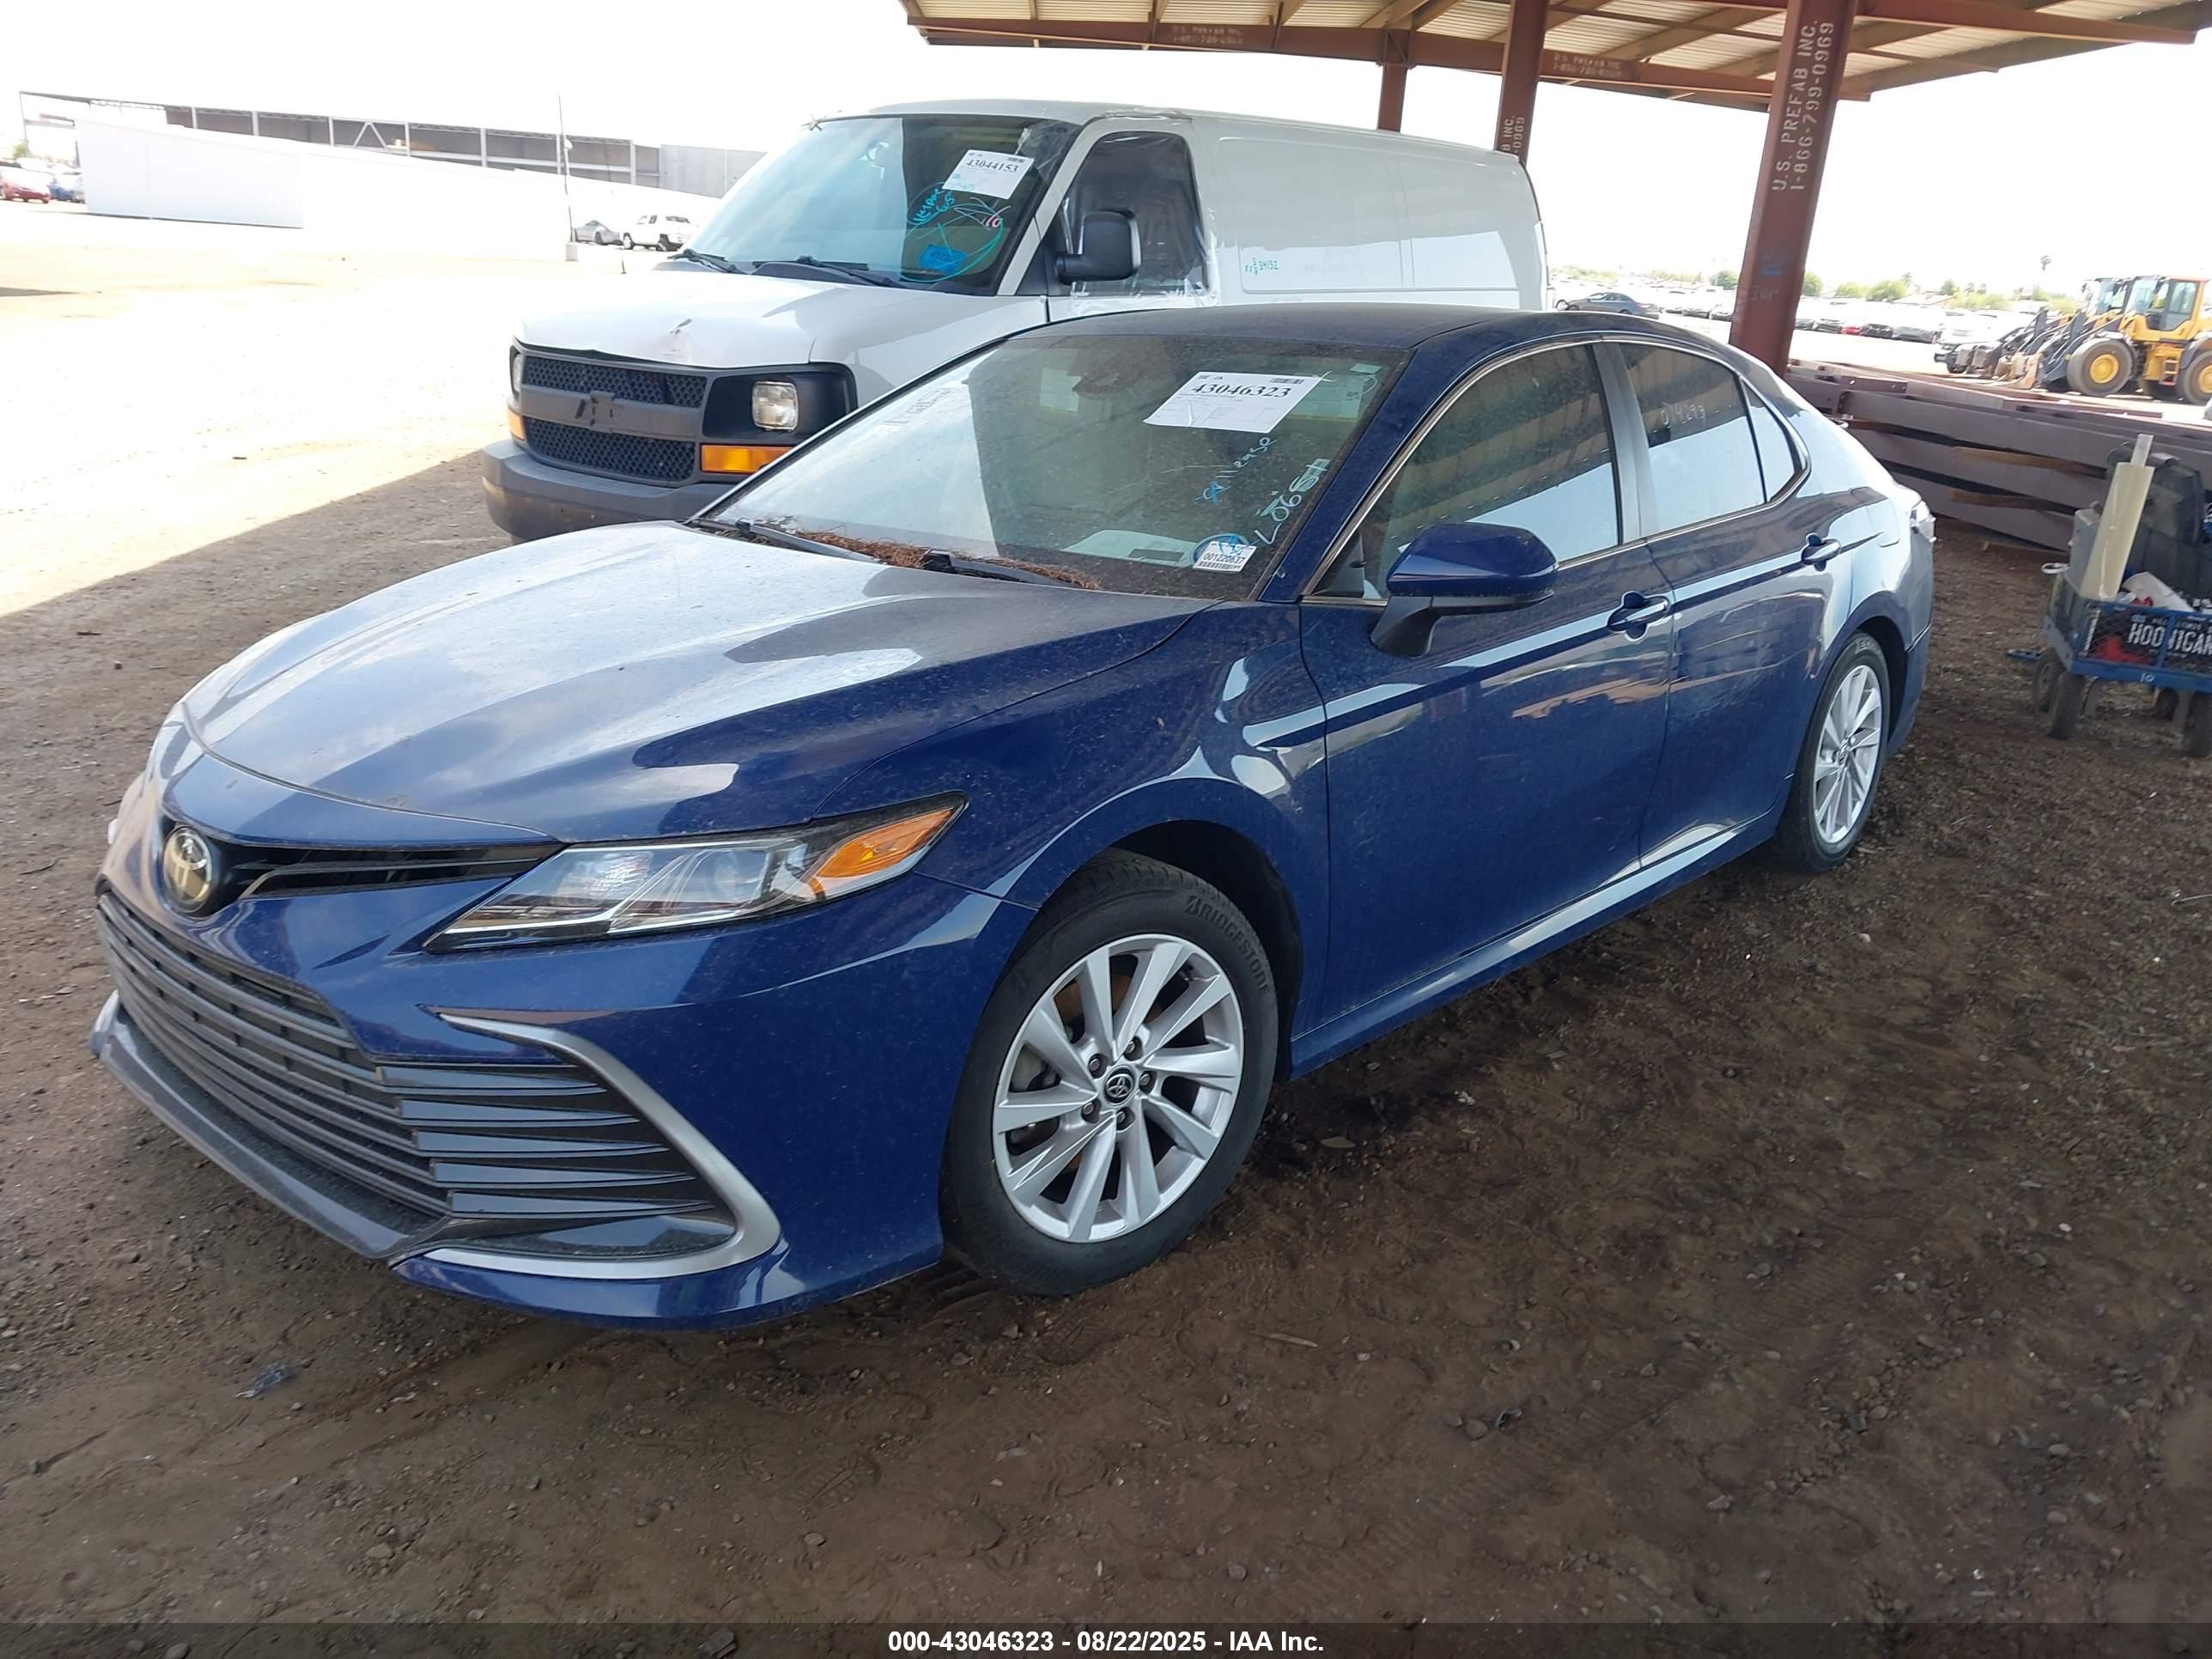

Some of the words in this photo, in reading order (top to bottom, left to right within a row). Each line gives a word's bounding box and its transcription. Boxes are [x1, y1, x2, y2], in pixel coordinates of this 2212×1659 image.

[1797, 20, 1819, 57] INC.
[1781, 68, 1808, 143] PREFAB
[1790, 22, 1835, 190] 1-866-799-0969
[966, 158, 1019, 173] 43044153
[1772, 154, 1792, 191] U.S.
[1191, 382, 1292, 398] 43046323
